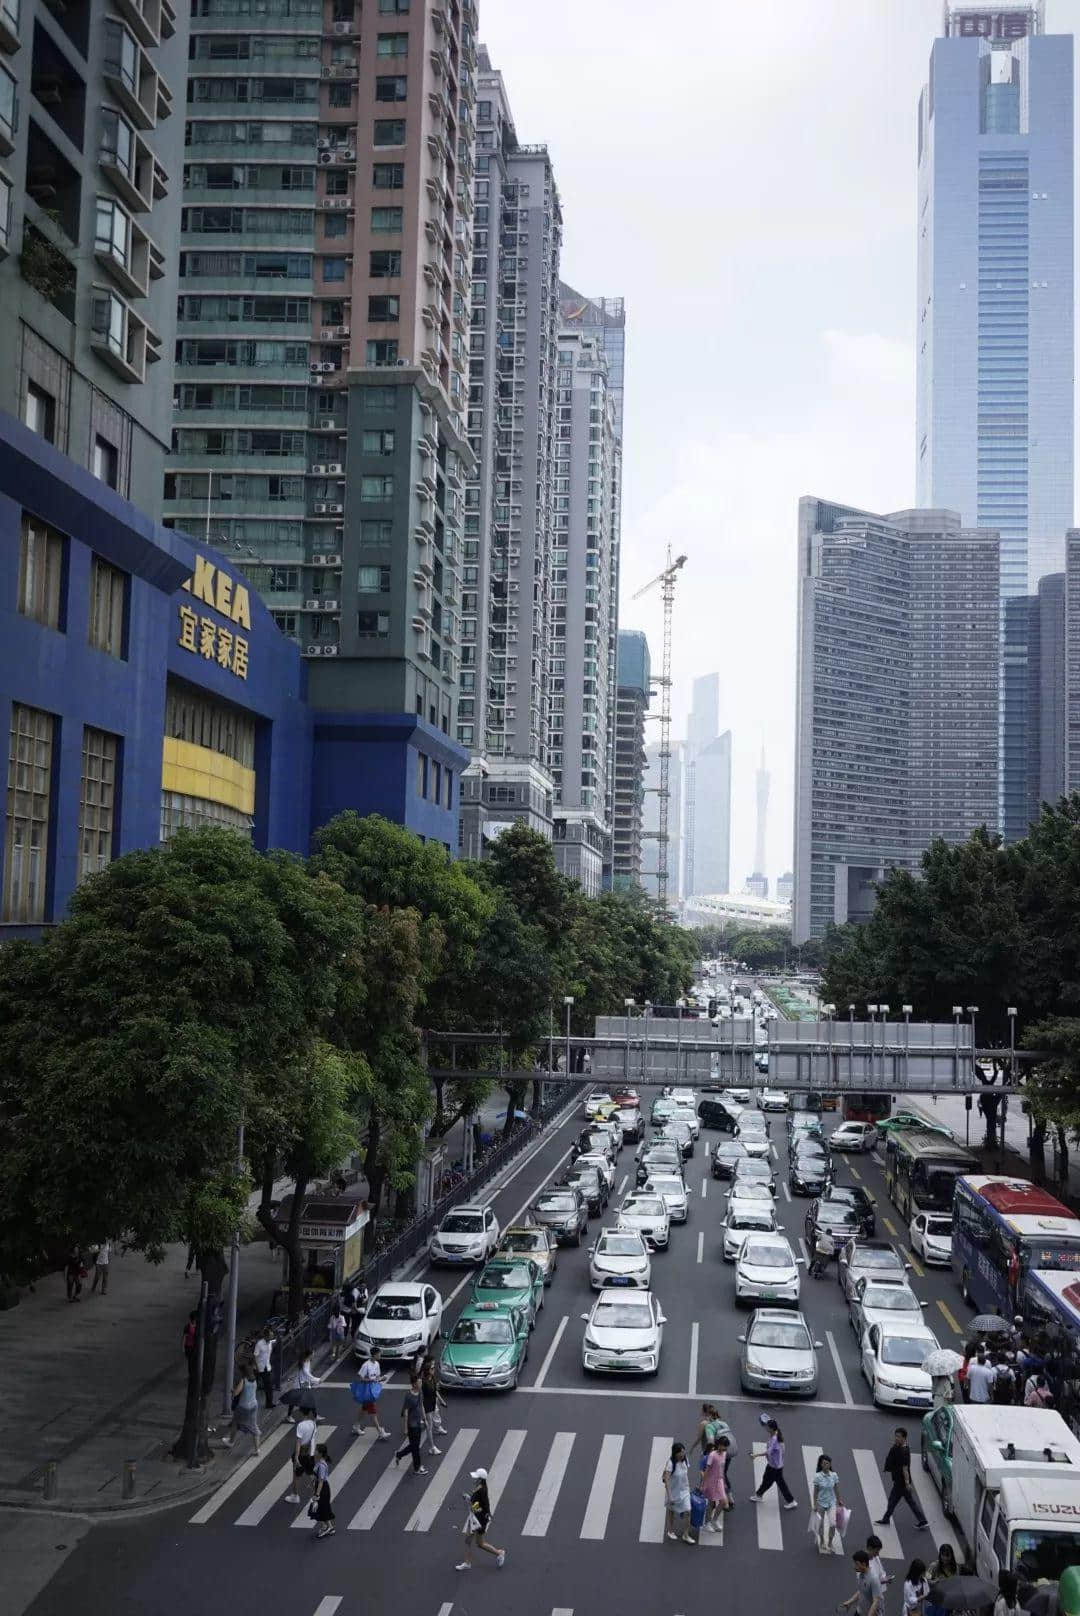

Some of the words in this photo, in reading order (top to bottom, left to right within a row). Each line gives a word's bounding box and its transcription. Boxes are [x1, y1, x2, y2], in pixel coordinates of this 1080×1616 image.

[181, 554, 251, 631] KEA
[179, 605, 249, 681] 宜家家居
